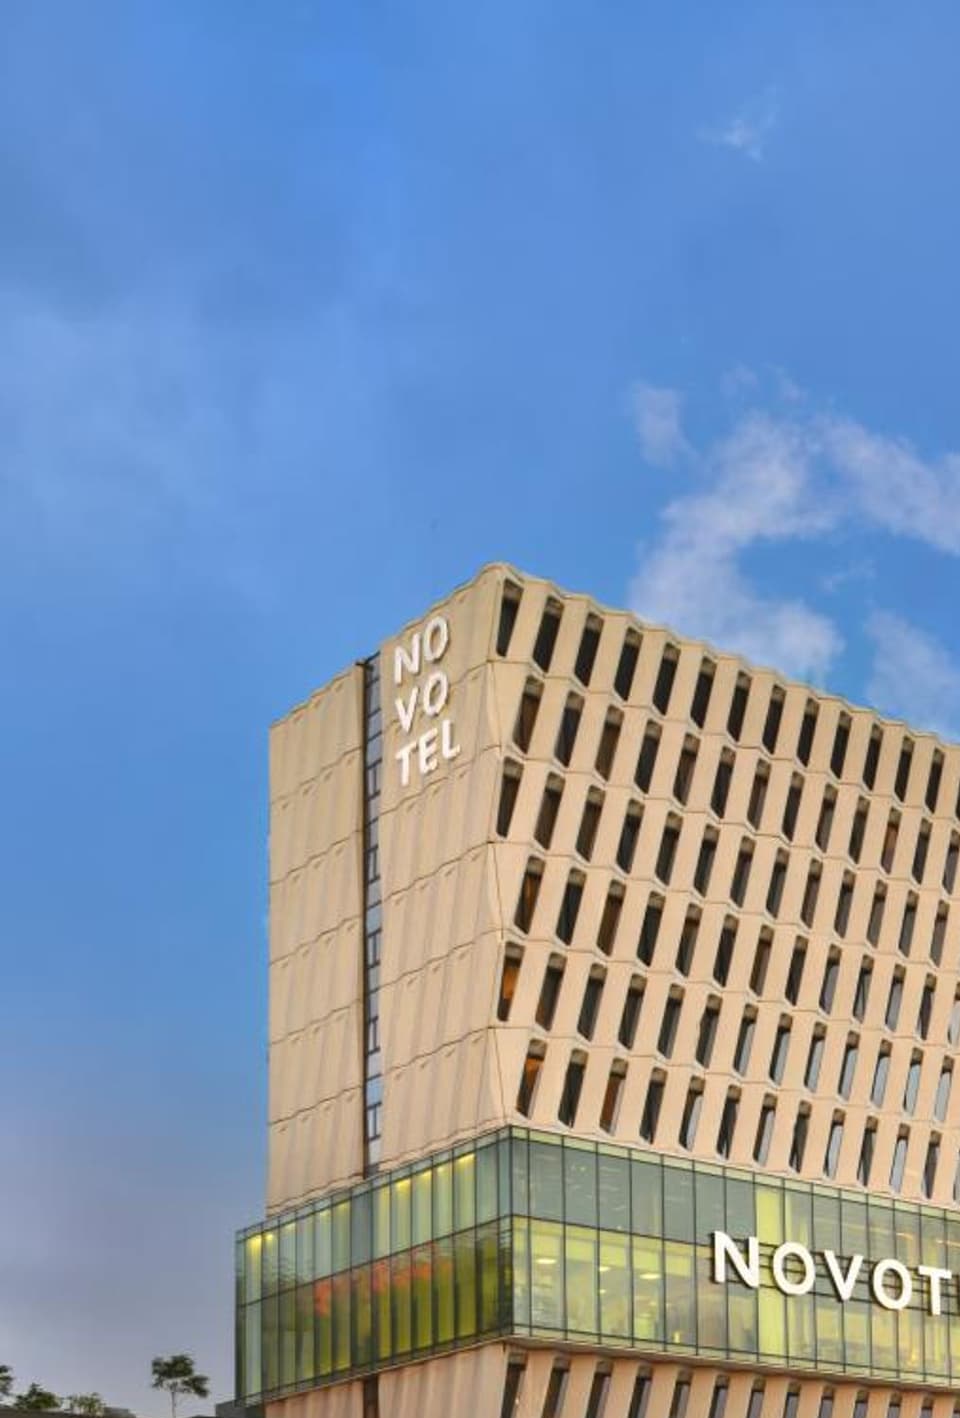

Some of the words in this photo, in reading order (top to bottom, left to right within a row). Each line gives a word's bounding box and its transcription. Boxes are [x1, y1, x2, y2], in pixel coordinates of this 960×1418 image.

[394, 615, 448, 685] NO
[395, 671, 448, 732] VO
[396, 719, 460, 786] TEL
